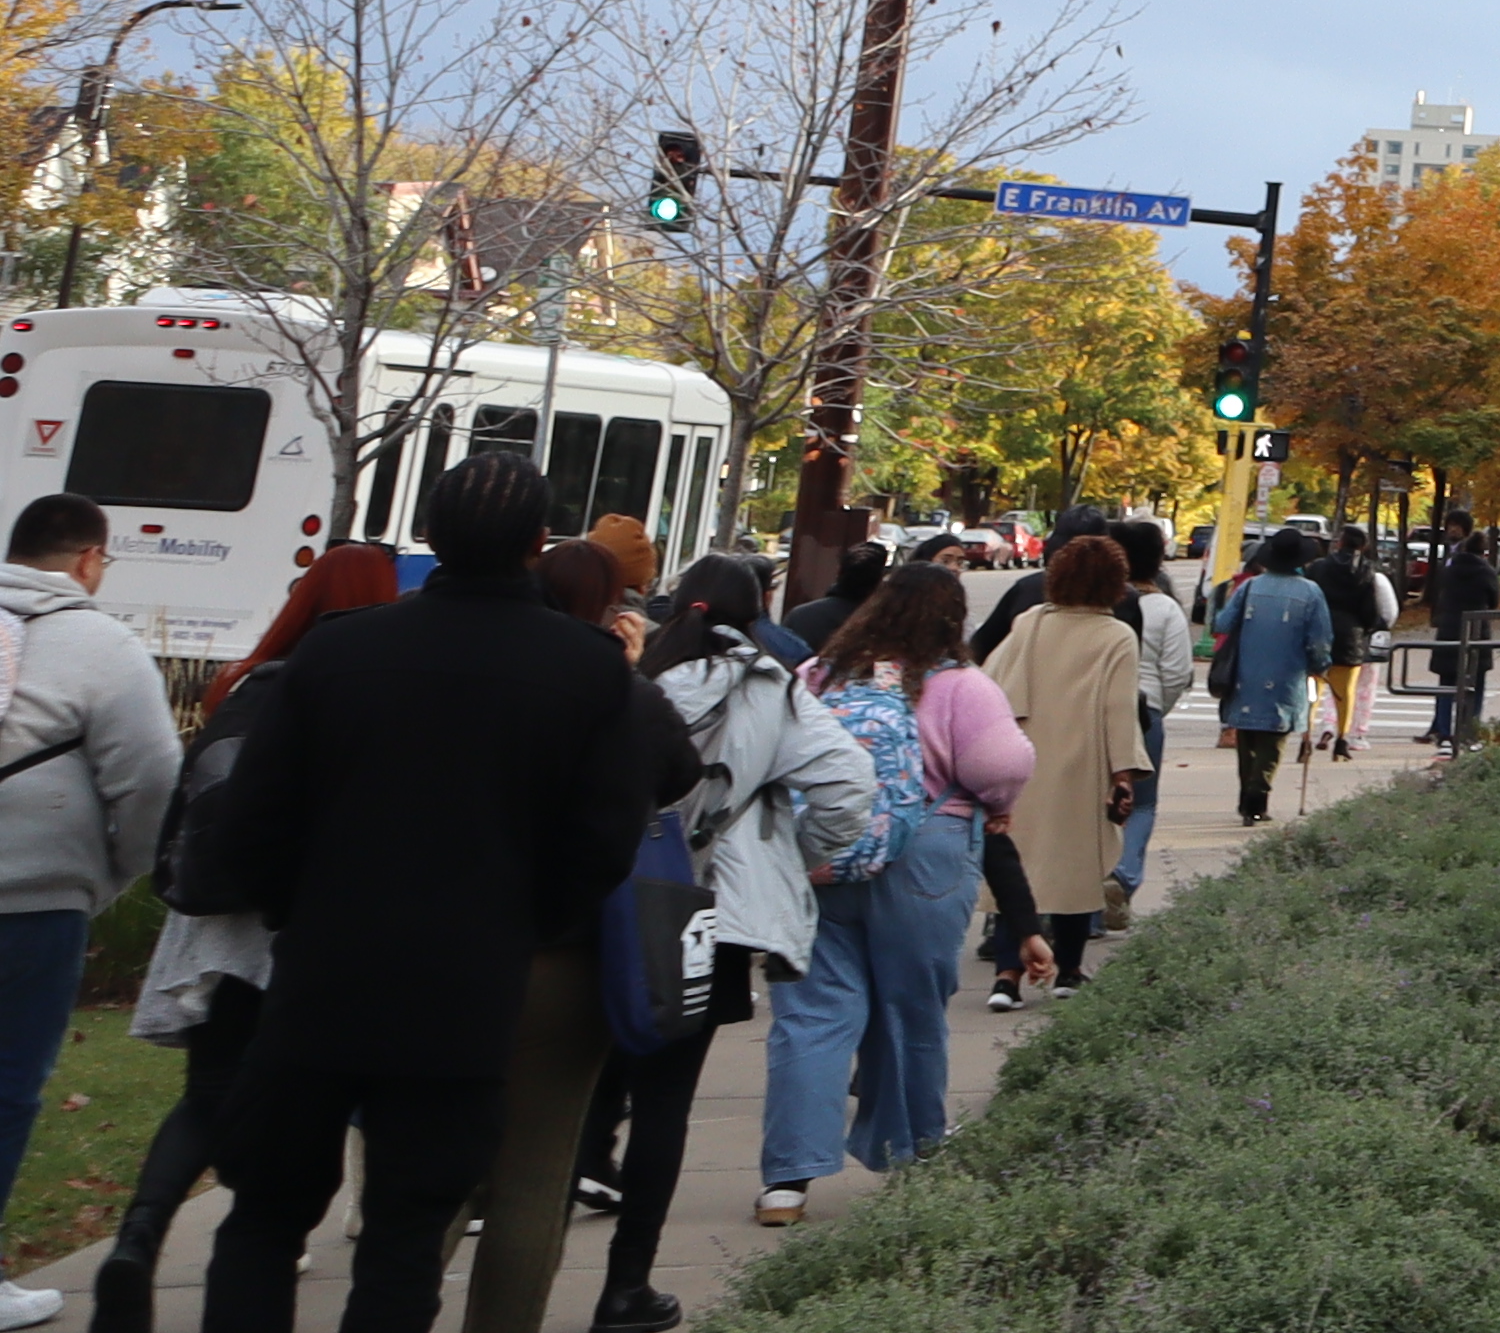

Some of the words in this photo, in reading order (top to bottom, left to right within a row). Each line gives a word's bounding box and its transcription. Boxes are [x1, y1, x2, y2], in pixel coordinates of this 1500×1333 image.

[1003, 188, 1021, 208] E
[1030, 190, 1137, 217] Franklin
[1147, 200, 1183, 221] Av
